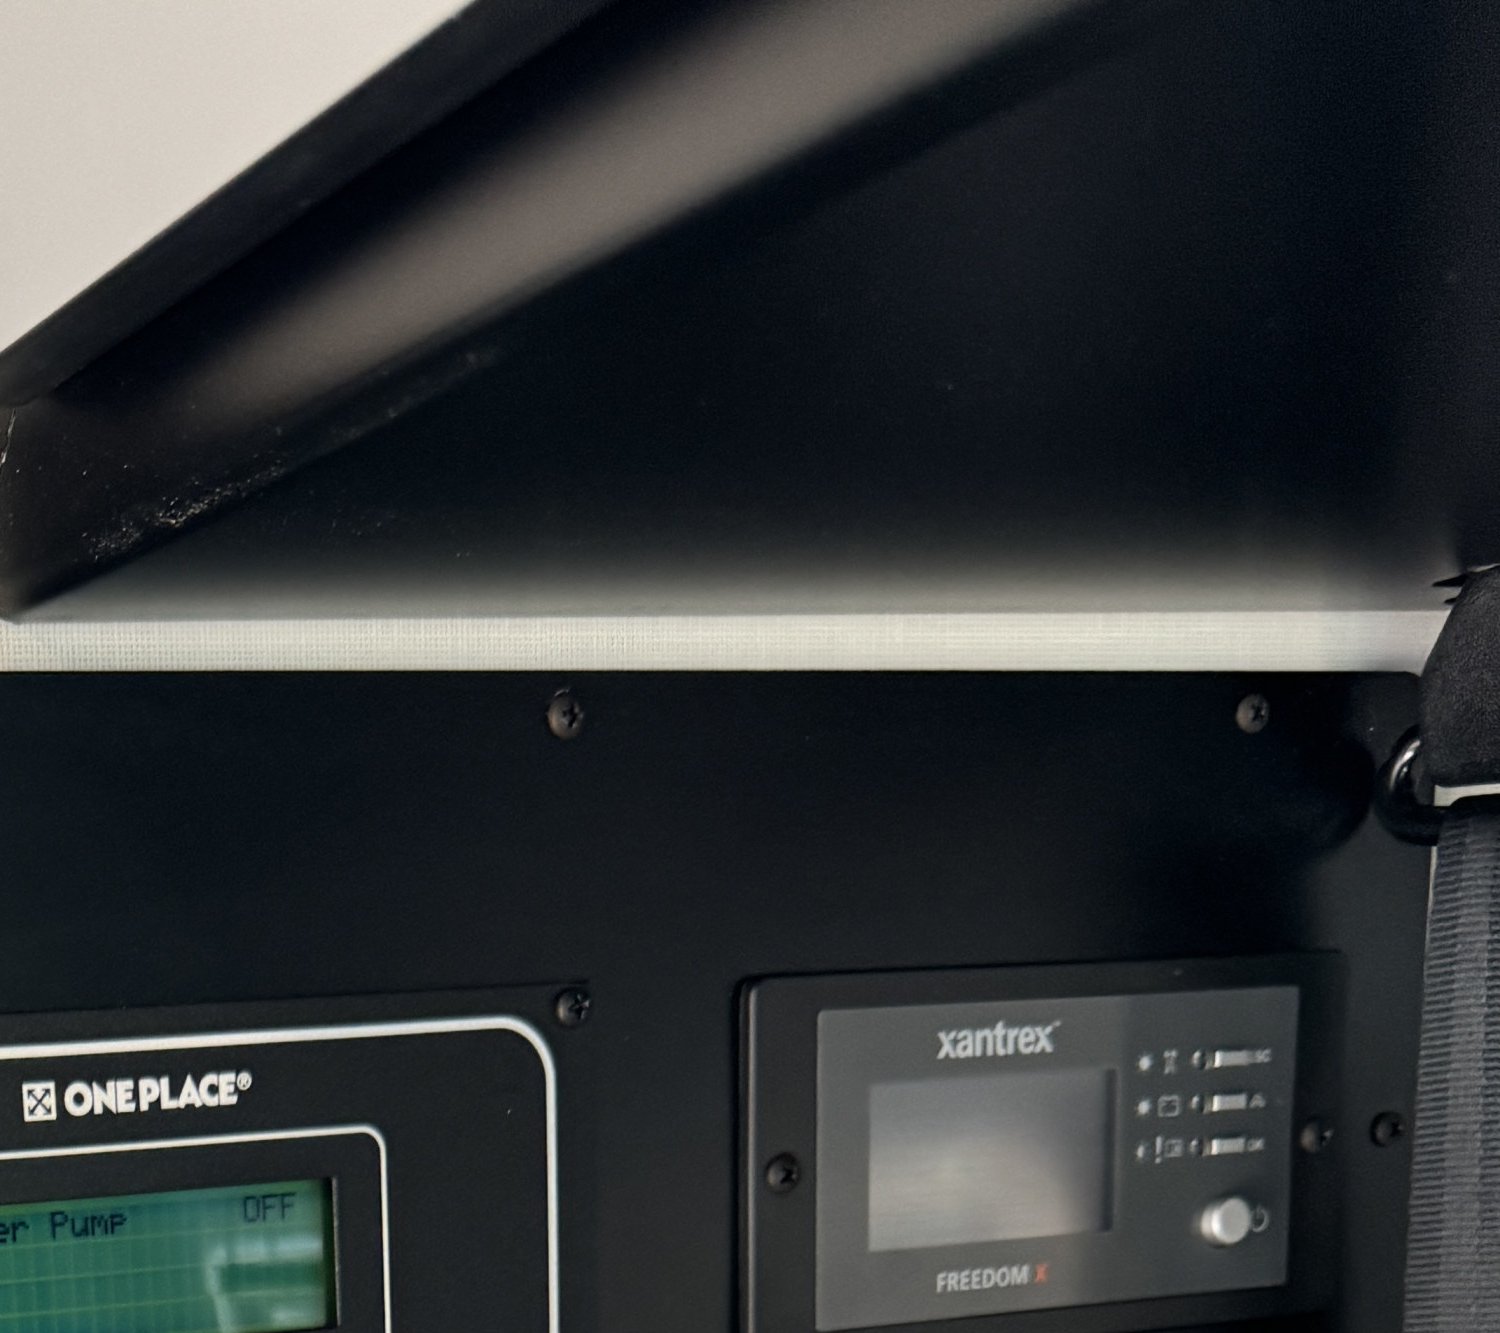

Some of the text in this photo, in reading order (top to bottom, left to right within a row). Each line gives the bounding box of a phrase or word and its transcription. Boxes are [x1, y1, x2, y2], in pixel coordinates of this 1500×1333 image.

[50, 1210, 127, 1240] Pump
[243, 1191, 298, 1225] OFF
[936, 1262, 1030, 1293] FREEDOM
